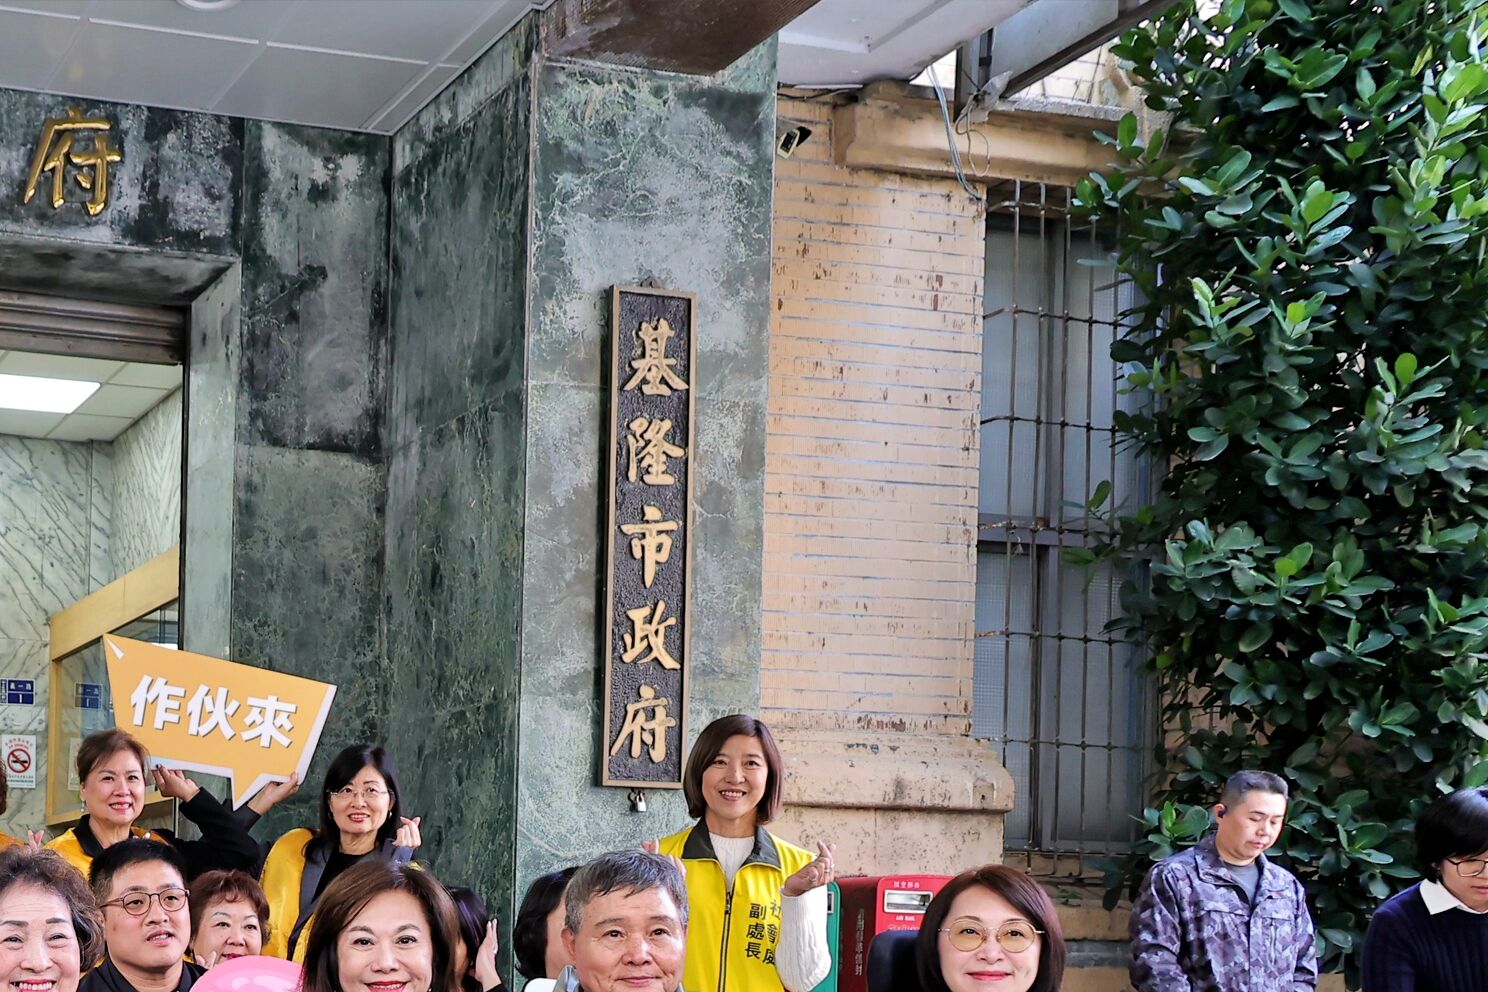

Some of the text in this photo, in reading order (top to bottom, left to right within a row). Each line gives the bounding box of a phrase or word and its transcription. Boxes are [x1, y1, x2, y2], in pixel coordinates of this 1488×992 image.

[612, 317, 689, 763] 基隆市政府
[130, 675, 298, 748] 作伙來
[745, 903, 766, 959] 副處長
